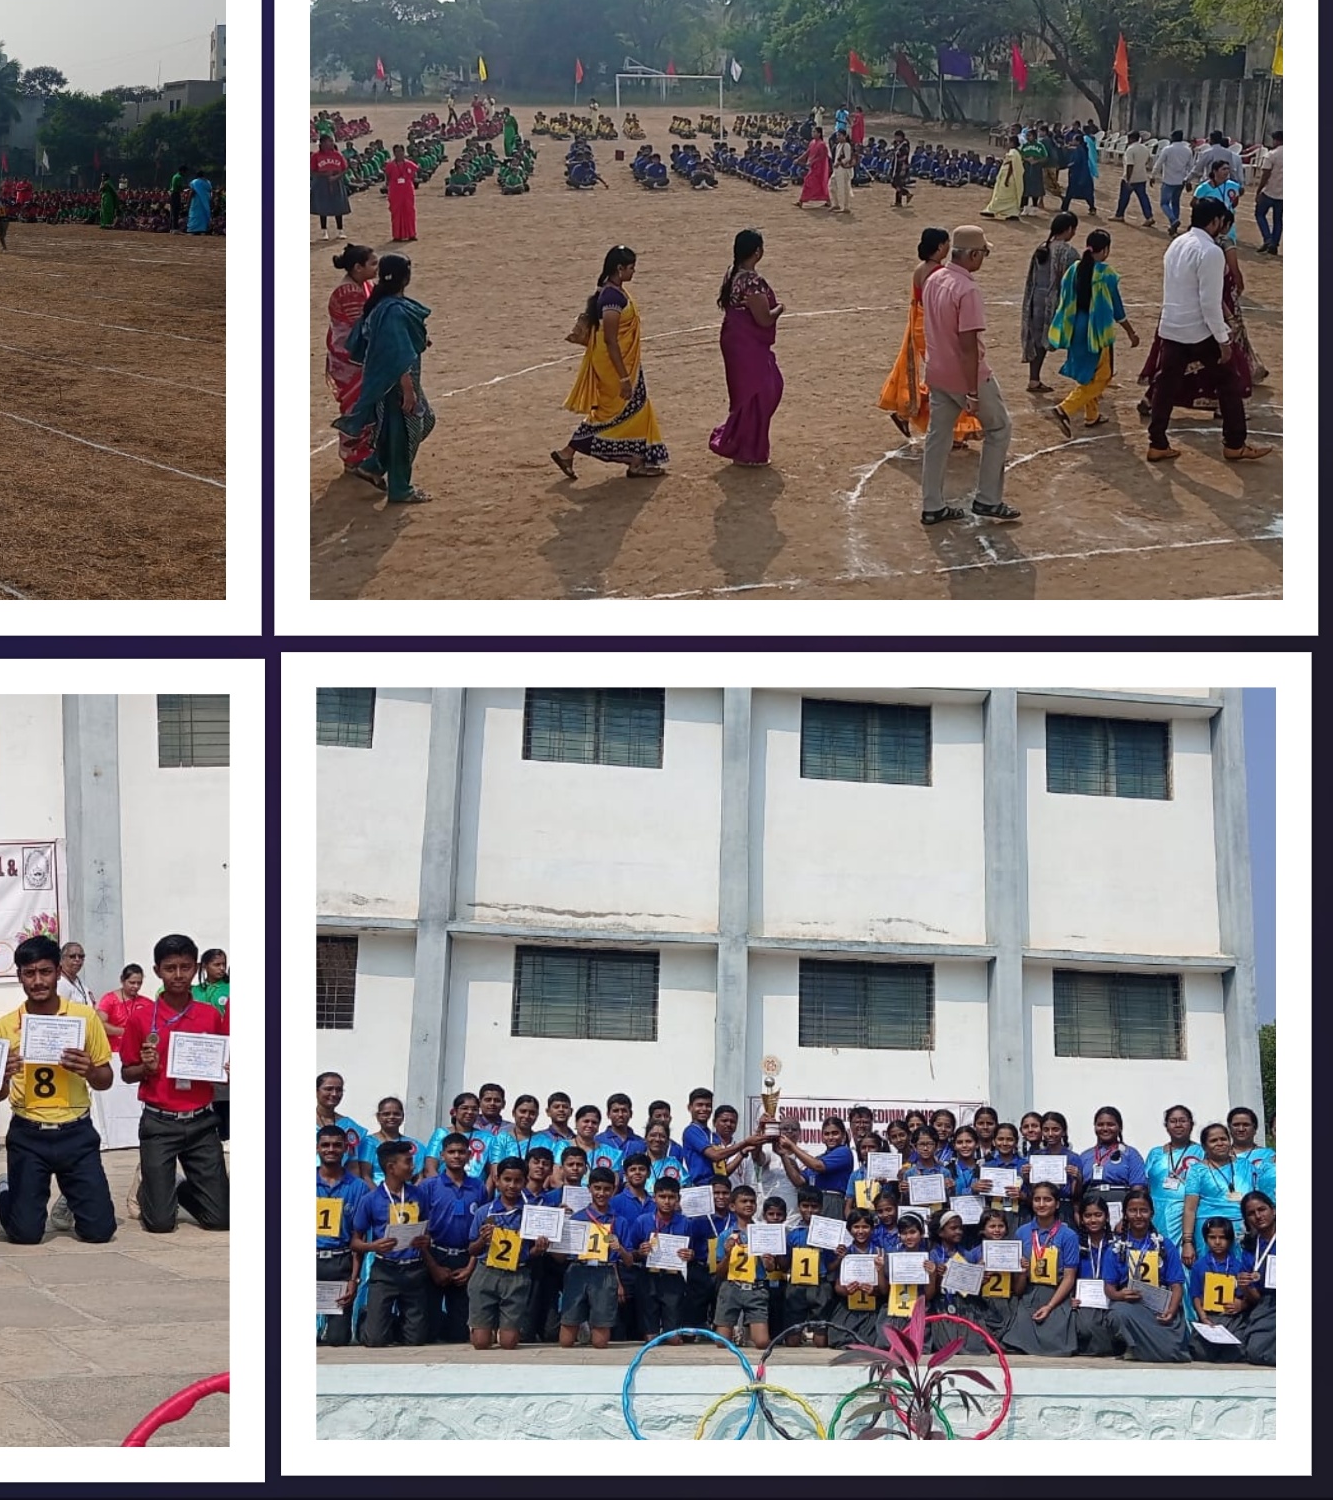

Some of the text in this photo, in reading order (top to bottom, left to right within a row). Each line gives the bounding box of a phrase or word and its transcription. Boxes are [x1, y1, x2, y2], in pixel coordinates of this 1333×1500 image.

[7, 858, 18, 877] &
[33, 1066, 57, 1098] 8
[779, 1106, 816, 1122] SHANTI
[873, 1109, 906, 1123] EDIUM
[318, 1209, 332, 1230] 1
[496, 1239, 512, 1262] 2
[588, 1233, 601, 1254] 1
[734, 1251, 748, 1273] 2
[801, 1257, 812, 1277] 1
[1139, 1262, 1151, 1282] 2
[990, 1273, 1003, 1291] 2
[1213, 1285, 1226, 1305] 1
